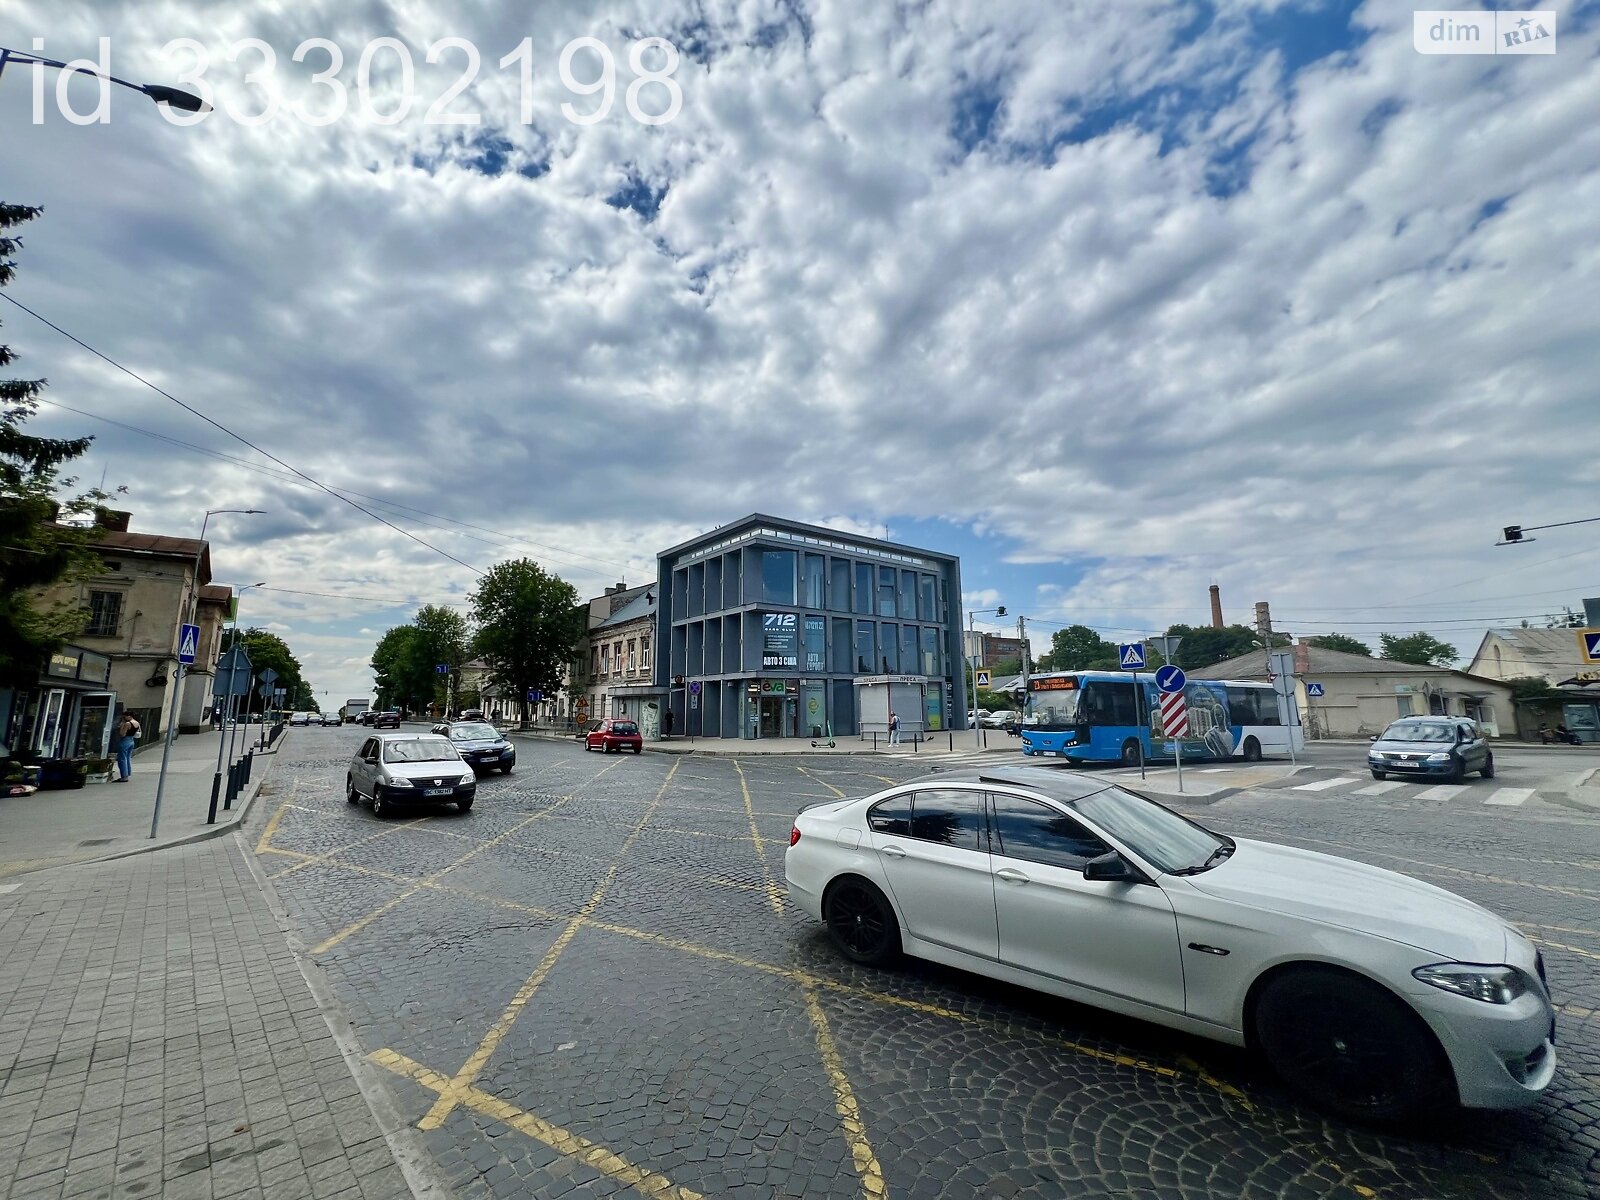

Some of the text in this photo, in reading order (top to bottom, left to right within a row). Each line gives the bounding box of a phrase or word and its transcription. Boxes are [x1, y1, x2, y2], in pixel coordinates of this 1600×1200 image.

[765, 613, 796, 626] 712
[763, 656, 779, 666] АВТО
[783, 656, 798, 666] США
